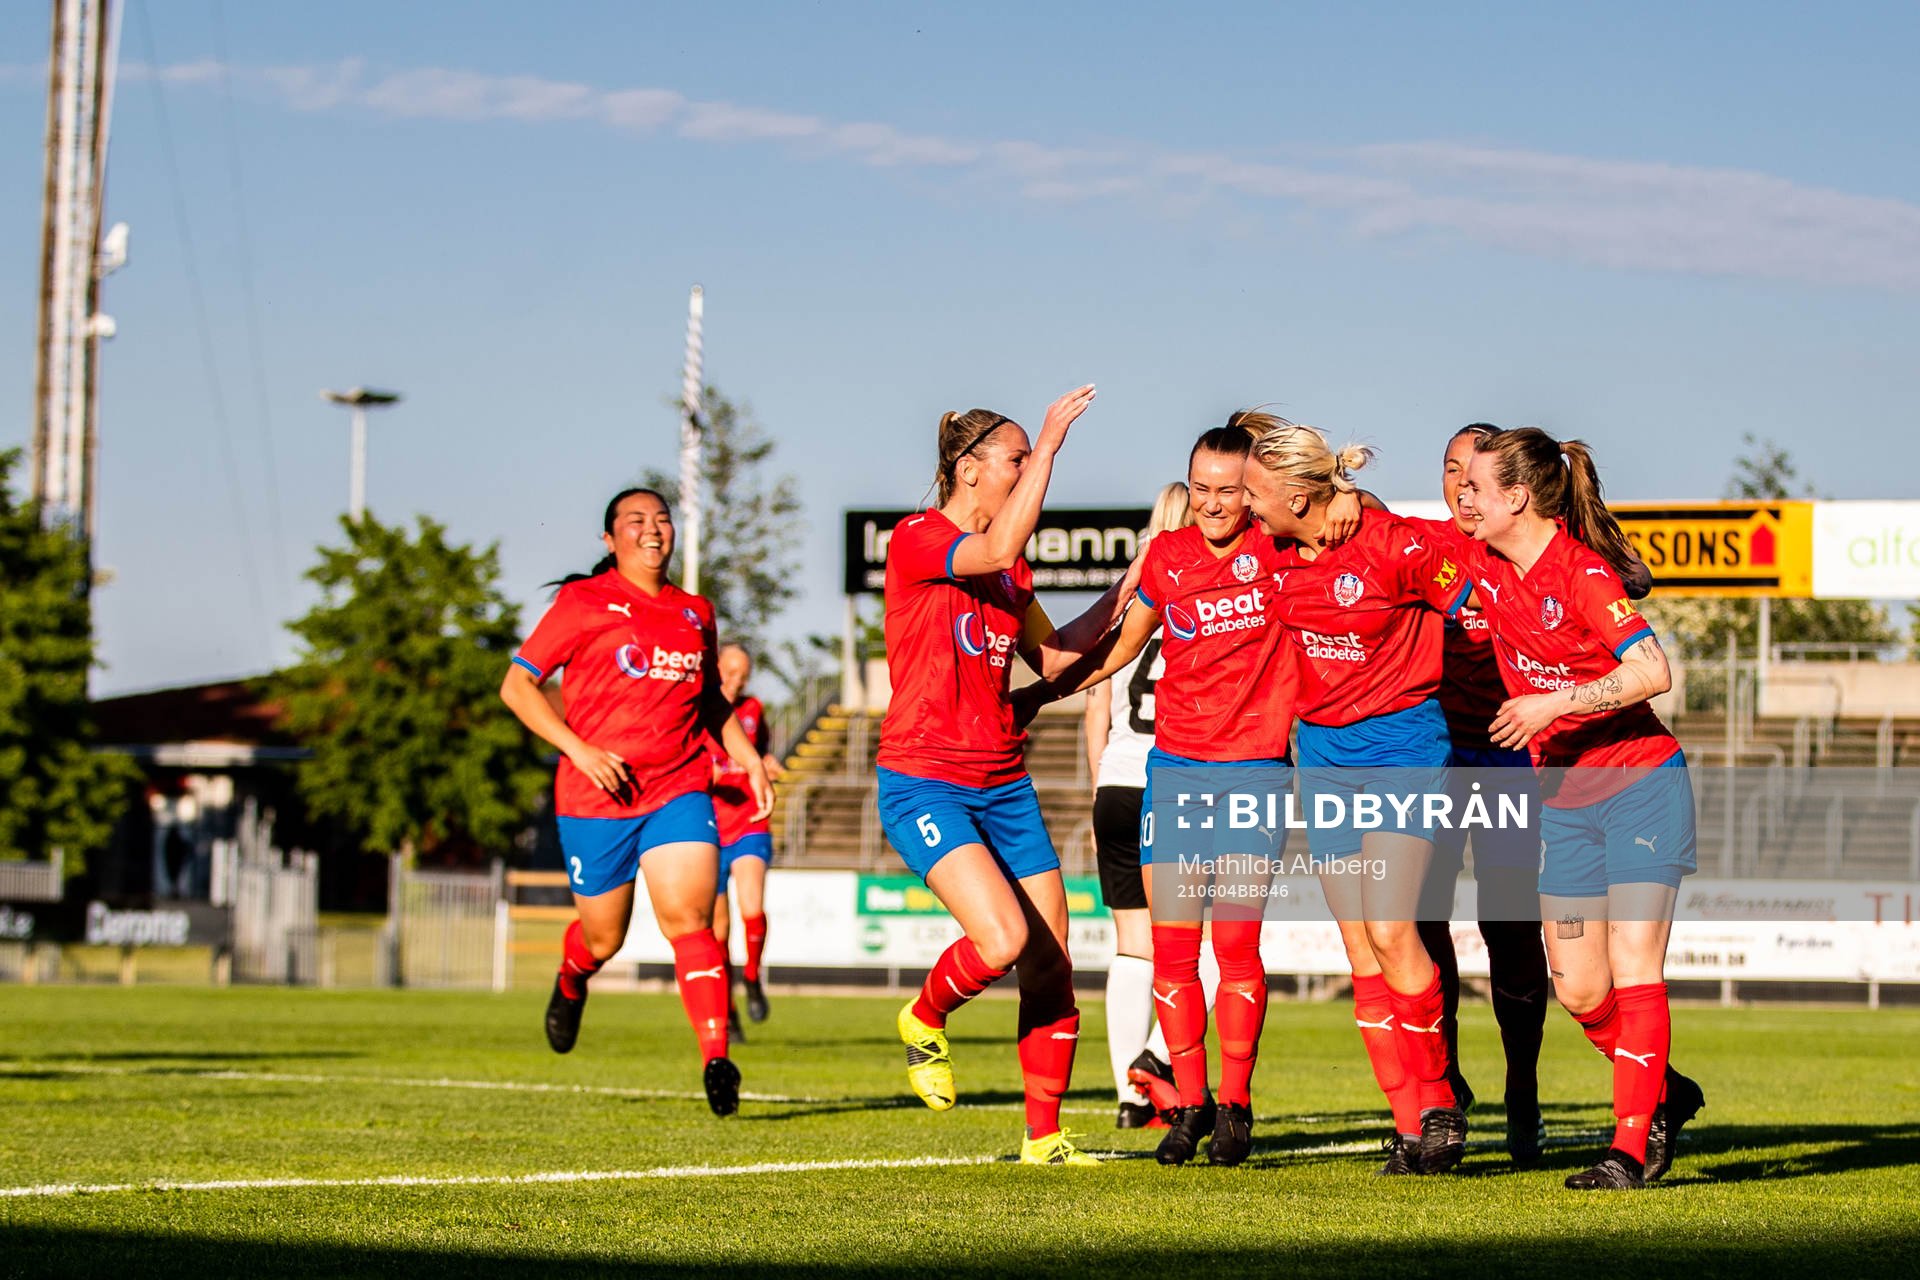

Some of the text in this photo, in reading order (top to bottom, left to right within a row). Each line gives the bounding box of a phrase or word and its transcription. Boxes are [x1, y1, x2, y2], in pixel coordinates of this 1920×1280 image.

[1195, 588, 1265, 622] beat
[1201, 615, 1266, 637] diabetes
[652, 646, 703, 671] beat
[1306, 644, 1366, 661] diabetes
[916, 813, 941, 847] 5
[570, 856, 584, 885] 2
